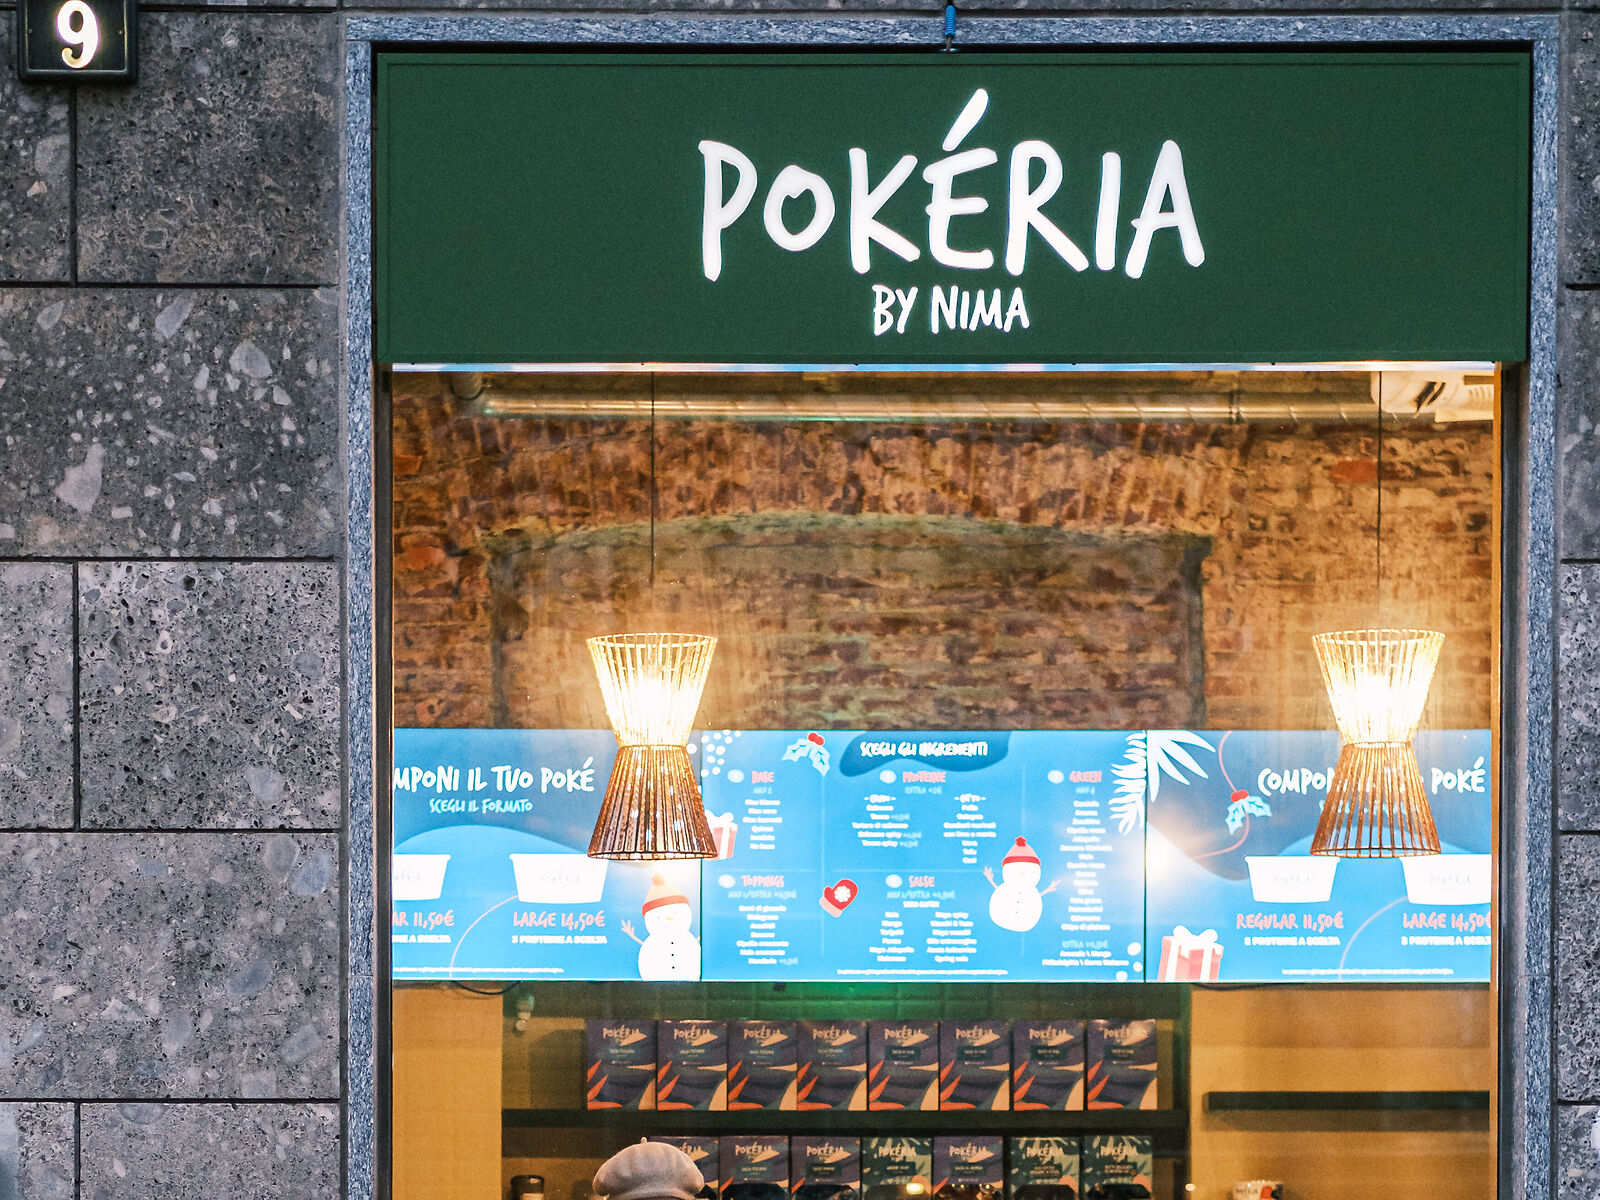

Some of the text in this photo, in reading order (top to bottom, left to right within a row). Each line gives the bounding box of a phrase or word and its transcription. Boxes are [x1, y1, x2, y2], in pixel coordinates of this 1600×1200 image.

[57, 0, 98, 69] 9
[698, 88, 1205, 282] POKÉRIA
[872, 283, 1030, 336] BY NIMA
[393, 756, 596, 794] MPONI IL TUO POKÉ
[1431, 756, 1486, 796] POKÉ
[429, 798, 534, 814] SCEGLI IL FORMATO
[413, 909, 455, 931] 11,50€
[513, 910, 606, 931] LARGE 14,50€
[1236, 911, 1344, 933] REGULAR 11,50€
[1402, 912, 1447, 930] LARGE
